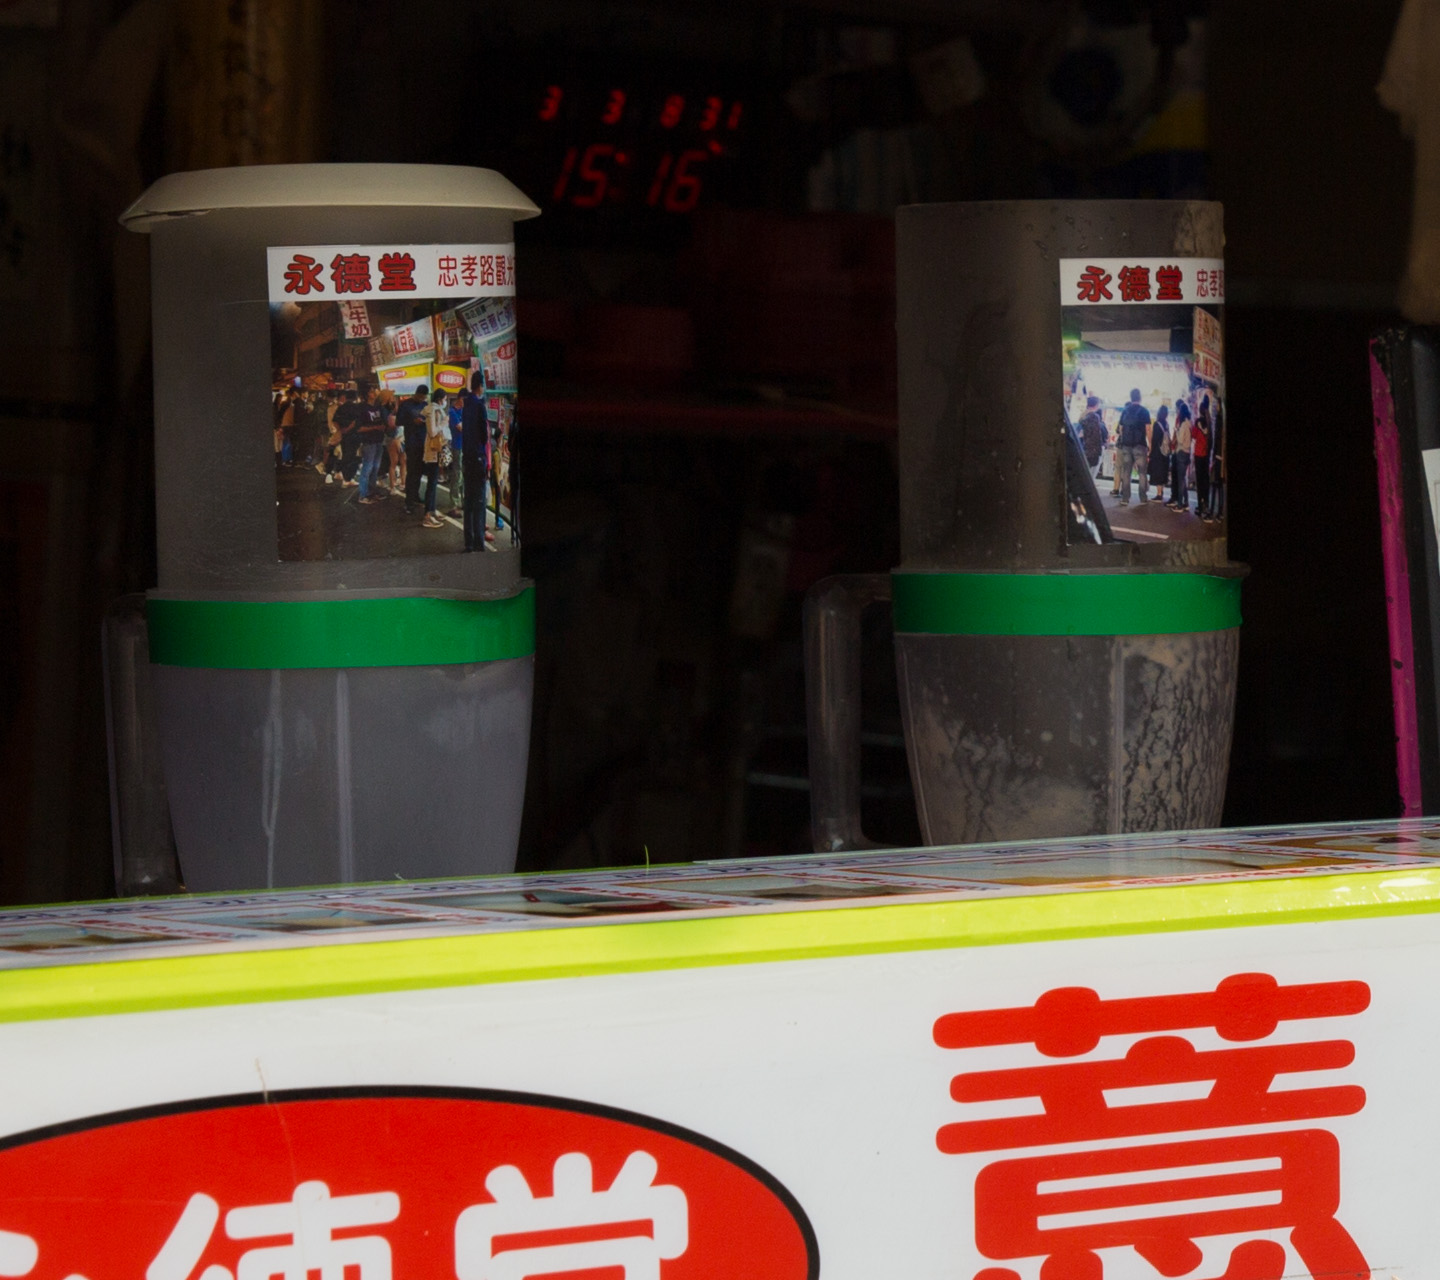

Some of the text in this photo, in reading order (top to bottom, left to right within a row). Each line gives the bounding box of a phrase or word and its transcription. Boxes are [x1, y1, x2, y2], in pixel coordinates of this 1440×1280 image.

[284, 252, 417, 295] 永德堂
[1076, 265, 1184, 302] 永德堂
